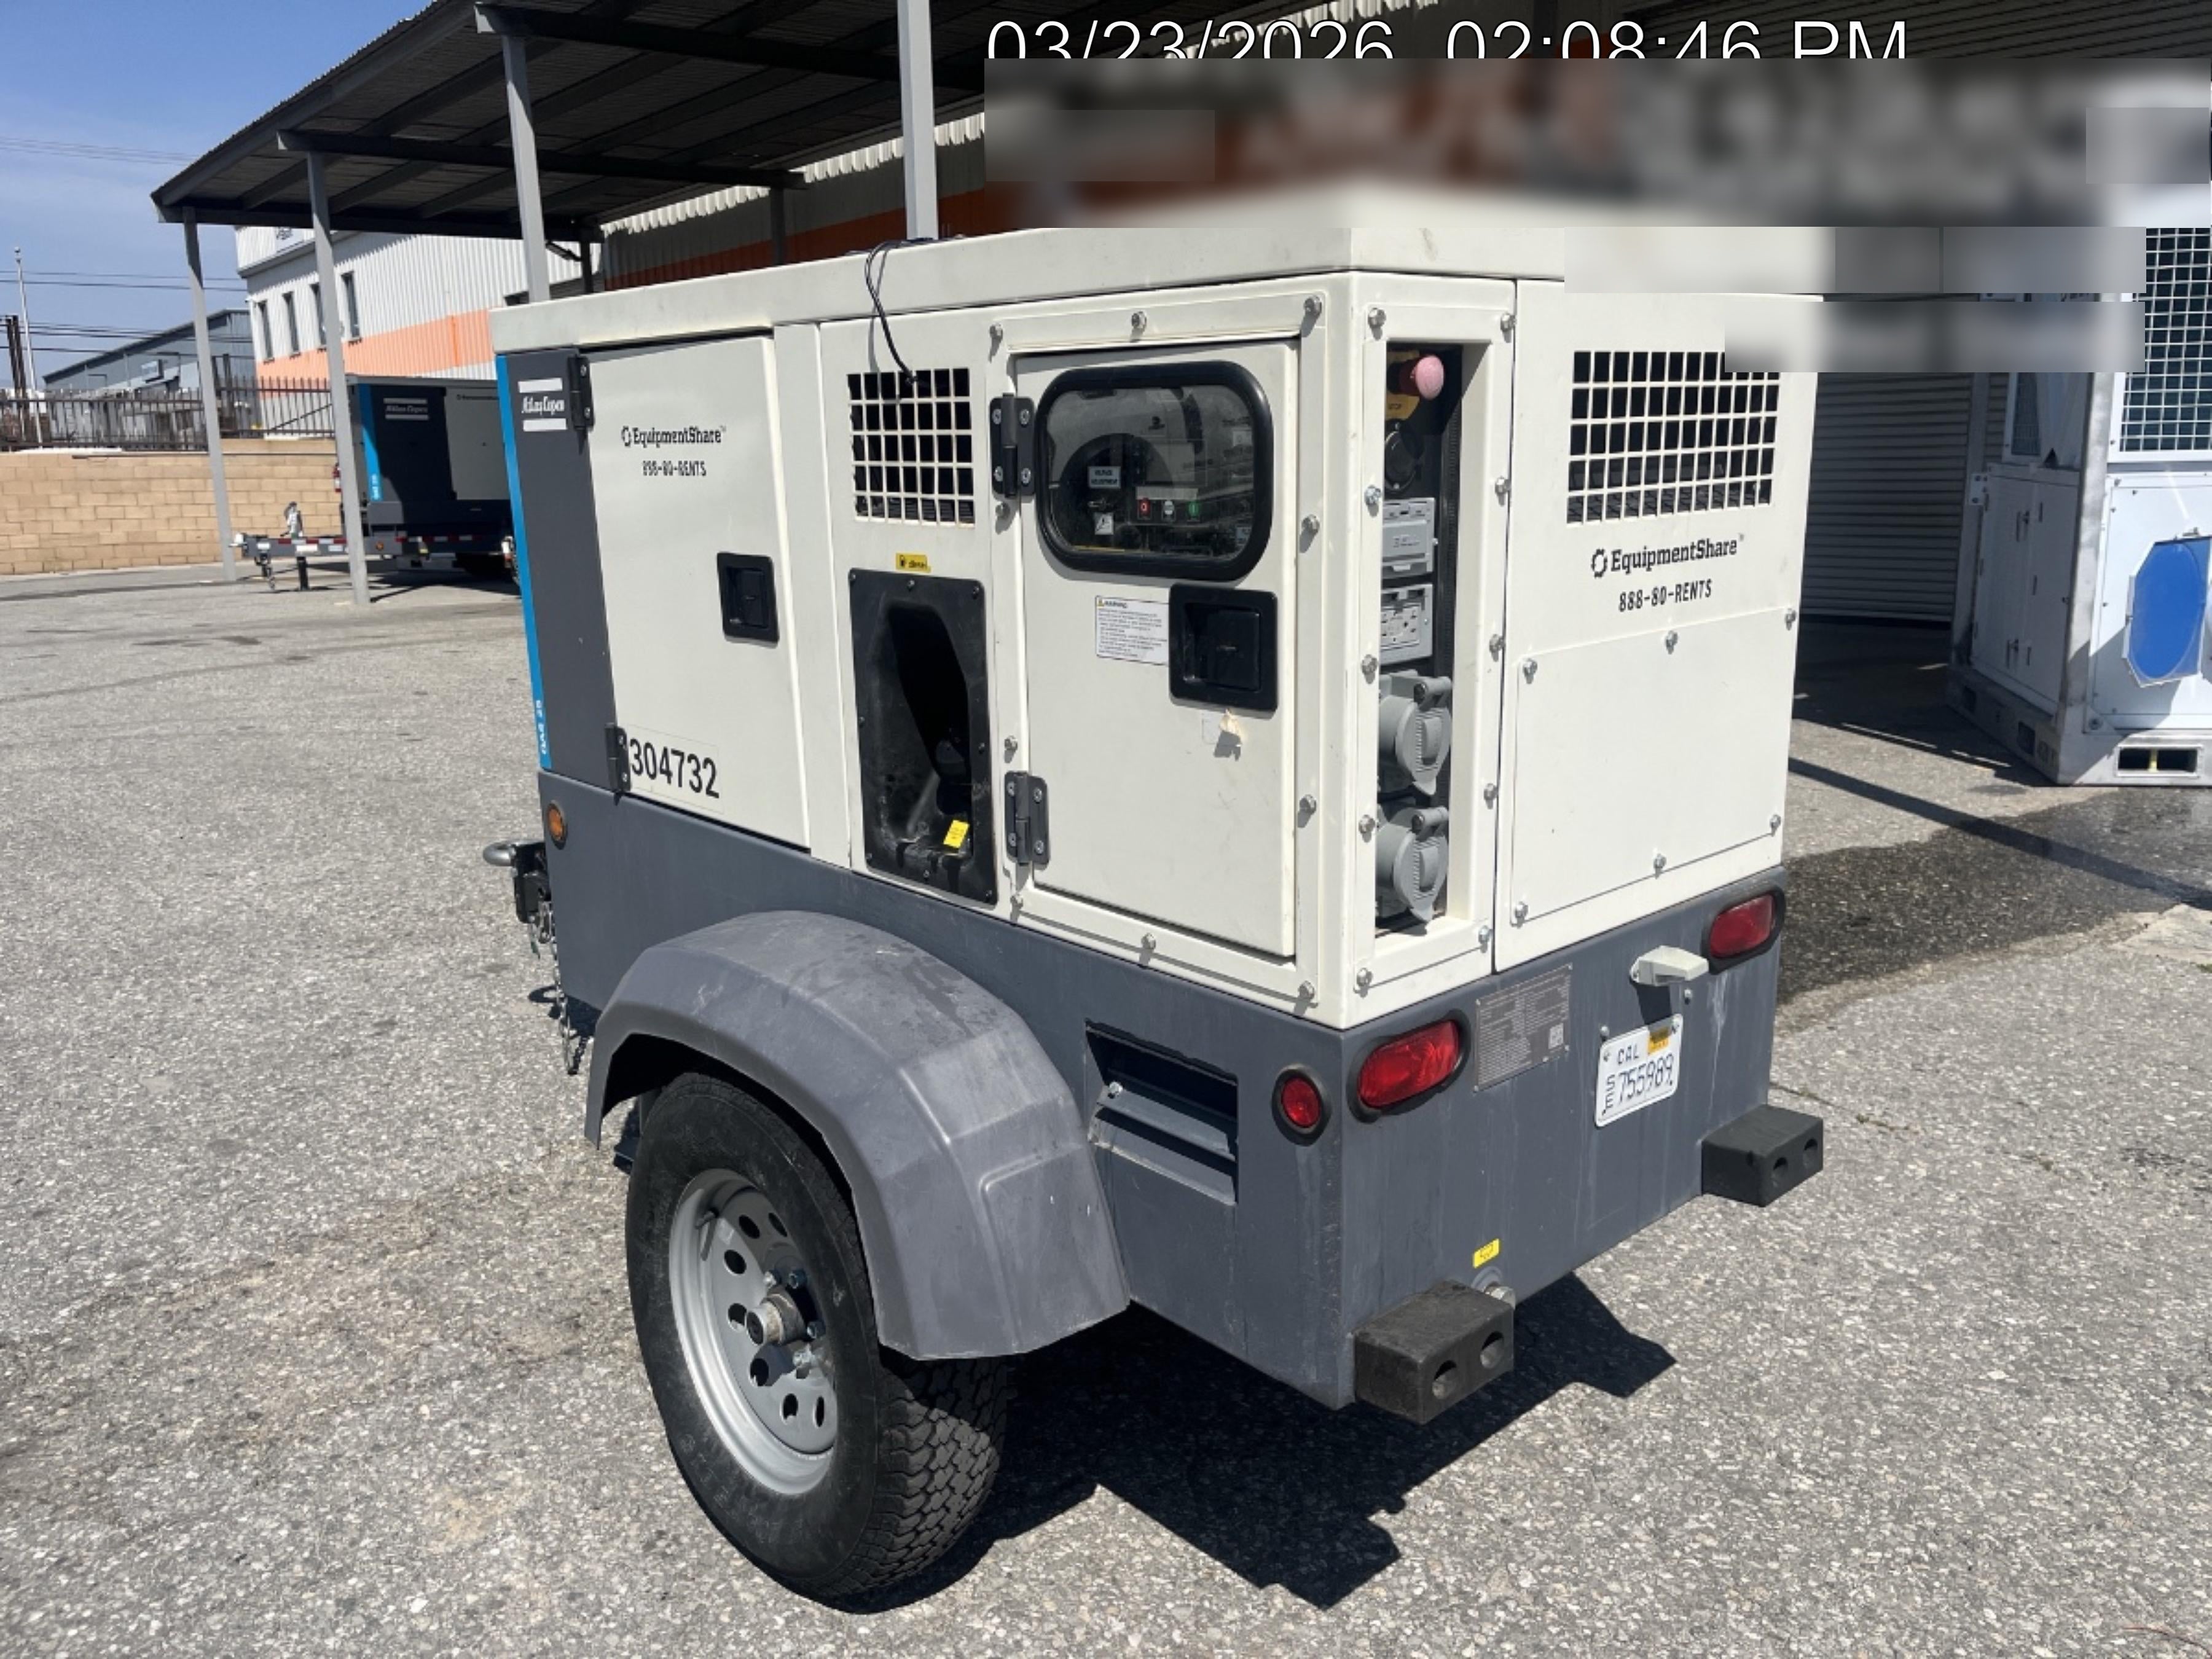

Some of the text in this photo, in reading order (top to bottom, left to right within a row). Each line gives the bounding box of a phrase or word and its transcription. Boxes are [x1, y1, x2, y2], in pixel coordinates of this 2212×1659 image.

[632, 426, 721, 448] EquipmentShare
[1610, 538, 1738, 575] EquipmentShare
[1618, 579, 1712, 612] 888-80-RENTS
[630, 738, 720, 799] 304732
[1617, 1043, 1639, 1065] CAL
